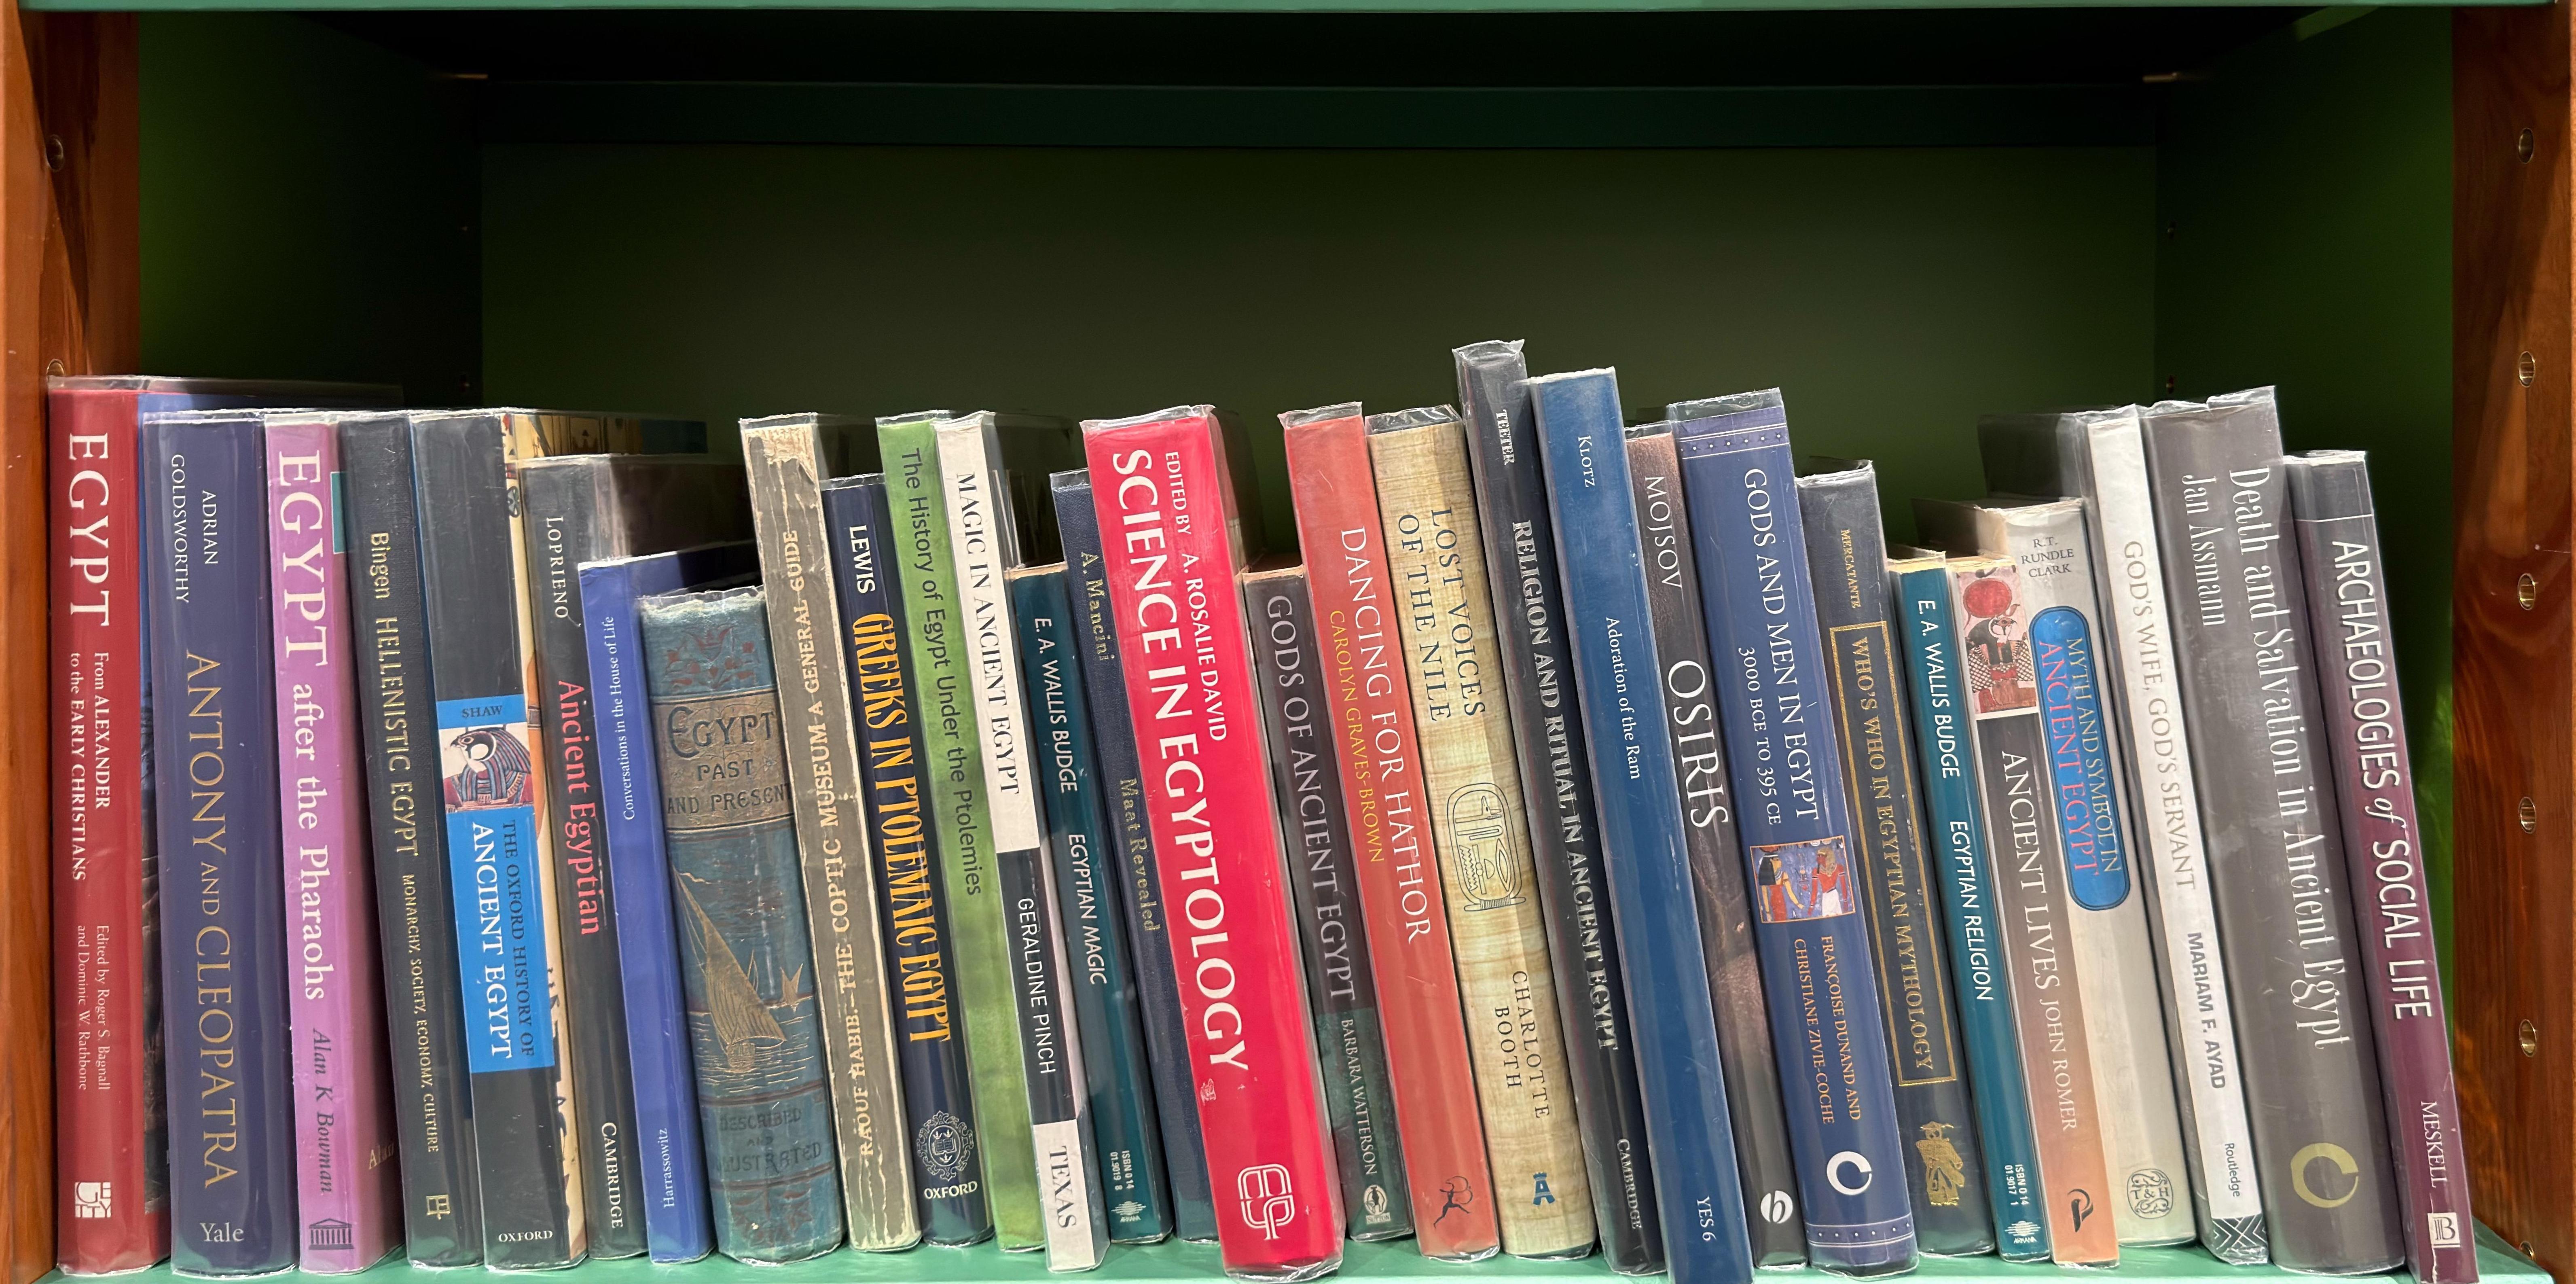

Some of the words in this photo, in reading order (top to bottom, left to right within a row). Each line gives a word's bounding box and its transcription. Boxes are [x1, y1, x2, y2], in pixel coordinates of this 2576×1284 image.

[901, 448, 920, 489] The
[1165, 451, 1186, 510] EDITED
[2181, 475, 2217, 515] Jan
[68, 432, 109, 627] EGYPT
[171, 454, 189, 603] GOLDSWORTHY
[202, 490, 218, 565] ADRIAN
[910, 496, 933, 572] History
[957, 473, 985, 553] MAGIC
[1174, 514, 1192, 535] BY
[1398, 515, 1424, 553] OF
[1645, 475, 1683, 589] MOJSOV
[1745, 468, 1776, 547] GODS
[2229, 466, 2280, 555] Death
[278, 451, 328, 666] EGYPT
[369, 532, 390, 599] Bingen
[546, 517, 569, 618] LOPRIENO
[850, 525, 876, 594] LEWIS
[970, 561, 989, 589] IN
[1112, 449, 1182, 652] SCIENCE
[1181, 553, 1200, 574] A.
[1511, 521, 1552, 645] RELIGION
[1757, 554, 1786, 613] AND
[1841, 529, 1860, 608] MERCATANTE
[2021, 547, 2074, 564] RUNDLE
[2029, 564, 2071, 578] CLARK
[2124, 541, 2153, 618] GOD'S
[2188, 524, 2227, 626] Assmann
[602, 616, 614, 637] Life
[923, 581, 942, 599] of
[1187, 579, 1215, 667] ROSALIE
[1342, 526, 1393, 699] DANCING
[1406, 566, 1437, 631] THE
[1431, 507, 1464, 590] LOST
[1448, 601, 1486, 717] VOICES
[1918, 599, 1937, 614] E.
[2244, 566, 2291, 621] and
[70, 653, 80, 667] to
[604, 638, 617, 653] of
[924, 609, 950, 668] Egypt
[975, 596, 1008, 705] ANCIENT
[1266, 595, 1304, 688] GODS
[1606, 617, 1628, 693] Adoration
[1768, 623, 1799, 684] MEN
[1920, 621, 1938, 635] A.
[2137, 623, 2163, 691] WIFE,
[70, 672, 84, 693] the
[94, 653, 109, 691] From
[376, 617, 411, 771] HELLENISTIC
[610, 653, 622, 695] House
[853, 613, 907, 729] GREEKS
[1149, 667, 1192, 720] IN
[1419, 644, 1452, 722] NILE
[1533, 653, 1560, 708] AND
[1738, 647, 1760, 691] 3000
[1926, 642, 1951, 708] WALLIS
[2254, 627, 2306, 777] Salvation
[2332, 541, 2400, 790] ARCHAEOLOGIES
[71, 700, 85, 758] EARLY
[293, 684, 323, 760] after
[559, 680, 591, 793] Ancient
[611, 698, 625, 716] the
[614, 718, 626, 733] in
[668, 707, 775, 757] EGYPT
[937, 675, 958, 740] Under
[1200, 670, 1227, 741] DAVID
[1284, 697, 1313, 738] OF
[1619, 696, 1635, 712] of
[1621, 713, 1637, 741] the
[1749, 698, 1766, 732] BCE
[1778, 693, 1804, 723] IN
[2148, 697, 2177, 773] GOD'S
[95, 696, 110, 809] ALEXANDER
[187, 650, 226, 855] ANTONY
[617, 735, 635, 820] Conversations
[870, 736, 914, 770] IN
[944, 746, 963, 783] the
[992, 714, 1019, 795] EGYPT
[1372, 710, 1404, 781] FOR
[1544, 713, 1576, 809] RITUAL
[1626, 746, 1640, 780] Ram
[1668, 660, 1728, 827] OSIRIS
[1757, 736, 1770, 761] TO
[1784, 733, 1819, 820] EGYPT
[1934, 714, 1960, 778] BUDGE
[297, 777, 328, 830] the
[1757, 766, 1777, 797] 395
[1766, 802, 1781, 824] CE
[2277, 786, 2314, 819] in
[2365, 797, 2405, 827] of
[71, 764, 86, 880] CHRISTIANS
[390, 782, 419, 856] EGYPT
[954, 790, 980, 896] Ptolemies
[1292, 751, 1338, 892] ANCIENT
[1560, 813, 1583, 844] IN
[2161, 782, 2195, 890] SERVANT
[201, 862, 219, 915] AND
[472, 821, 503, 956] ANCIENT
[566, 802, 600, 935] Egyptian
[874, 775, 937, 947] PTOLEMAIC
[1384, 790, 1430, 945] HATHOR
[1949, 821, 1980, 907] EGYPTIAN
[2002, 751, 2046, 892] ANCIENT
[2025, 905, 2060, 990] LIVES
[2283, 830, 2330, 949] Ancient
[2373, 841, 2423, 948] SOCIAL
[299, 846, 334, 1000] Pharaohs
[1069, 834, 1097, 920] EGYPTIAN
[1084, 927, 1107, 985] MAGIC
[1160, 733, 1249, 1072] EGYPTOLOGY
[1567, 851, 1603, 962] ANCIENT
[95, 967, 109, 984] by
[97, 925, 110, 966] Edited
[1316, 902, 1356, 1000] EGYPT
[1964, 915, 1994, 1000] RELIGION
[2187, 933, 2214, 1013] MARIAM
[95, 989, 110, 1026] Roger
[486, 964, 511, 1058] EGYPT
[900, 953, 951, 1043] EGYPT
[1018, 898, 1046, 1009] GERALDINE
[1034, 1014, 1056, 1074] PINCH
[1588, 969, 1618, 1050] EGYPT
[2290, 958, 2349, 1049] Egypt
[2389, 960, 2432, 1020] LIFE
[97, 1029, 110, 1042] S.
[195, 927, 238, 1189] CLEOPATRA
[313, 1028, 334, 1075] Alan
[1494, 1006, 1522, 1088] BOOTH
[1512, 971, 1549, 1118] CHARLOTTE
[2201, 1019, 2217, 1033] F.
[95, 1045, 110, 1090] Bagnall
[315, 1085, 333, 1103] K
[2039, 1000, 2065, 1053] JOHN
[2052, 1059, 2076, 1131] ROMER
[2204, 1041, 2226, 1089] AYAD
[317, 1111, 334, 1193] Bowman
[601, 1122, 622, 1229] CAMBRIDGE
[659, 1128, 674, 1208] Harrassowitz
[2015, 1164, 2026, 1185] ISBN
[2225, 1142, 2240, 1198] Routledge
[2421, 1101, 2448, 1188] MESKELL
[924, 1181, 978, 1199] OXFORD
[1049, 1145, 1076, 1229] TEXAS
[200, 1223, 244, 1243] Yale
[499, 1231, 553, 1242] OXFORD
